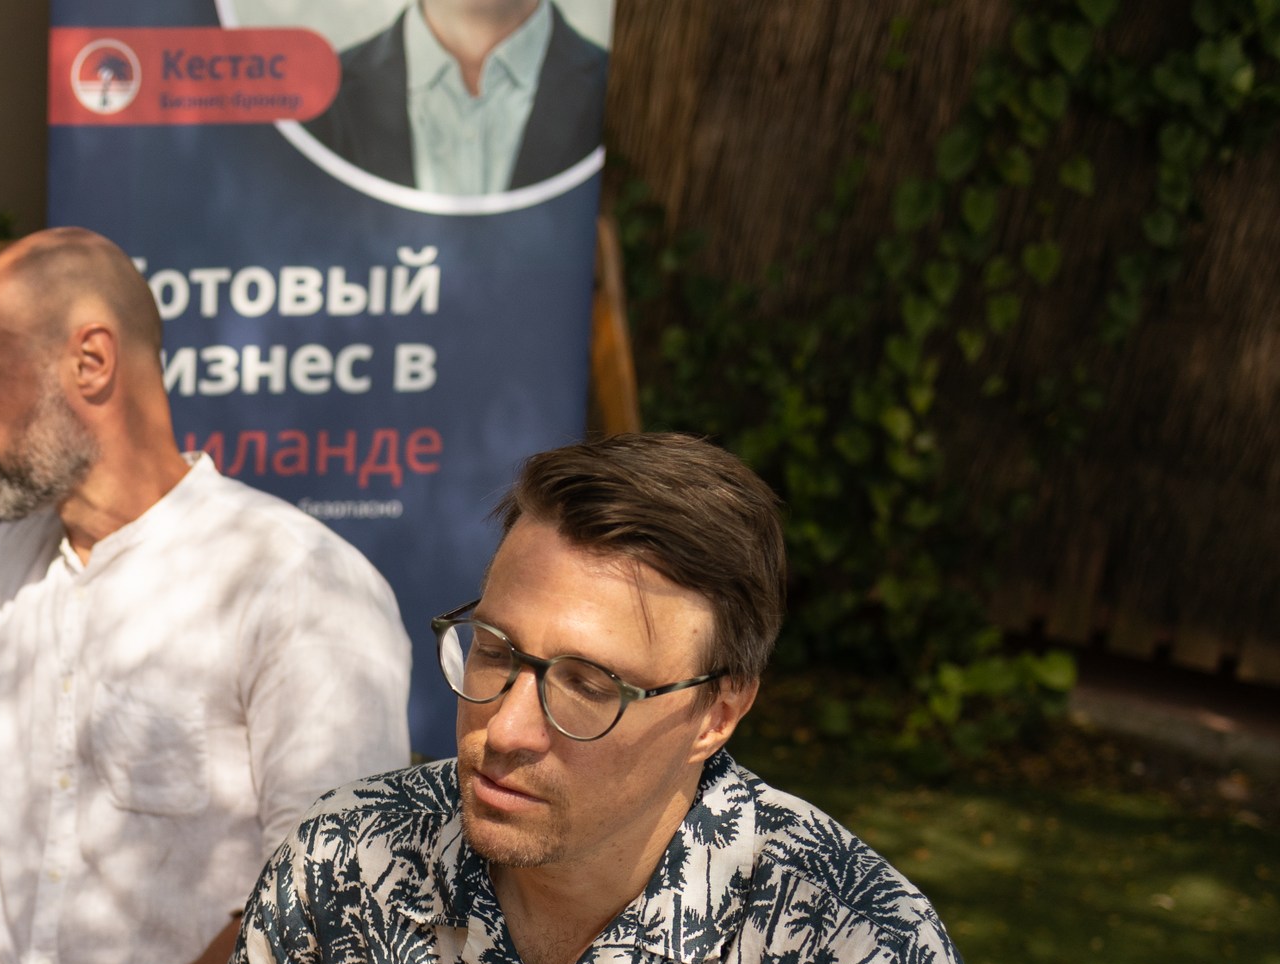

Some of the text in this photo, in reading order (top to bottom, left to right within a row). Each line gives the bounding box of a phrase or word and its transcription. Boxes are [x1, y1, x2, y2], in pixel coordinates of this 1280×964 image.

[162, 49, 287, 81] Кестас
[131, 245, 441, 320] отовый
[161, 343, 437, 397] изнес в
[184, 426, 444, 489] иланде
